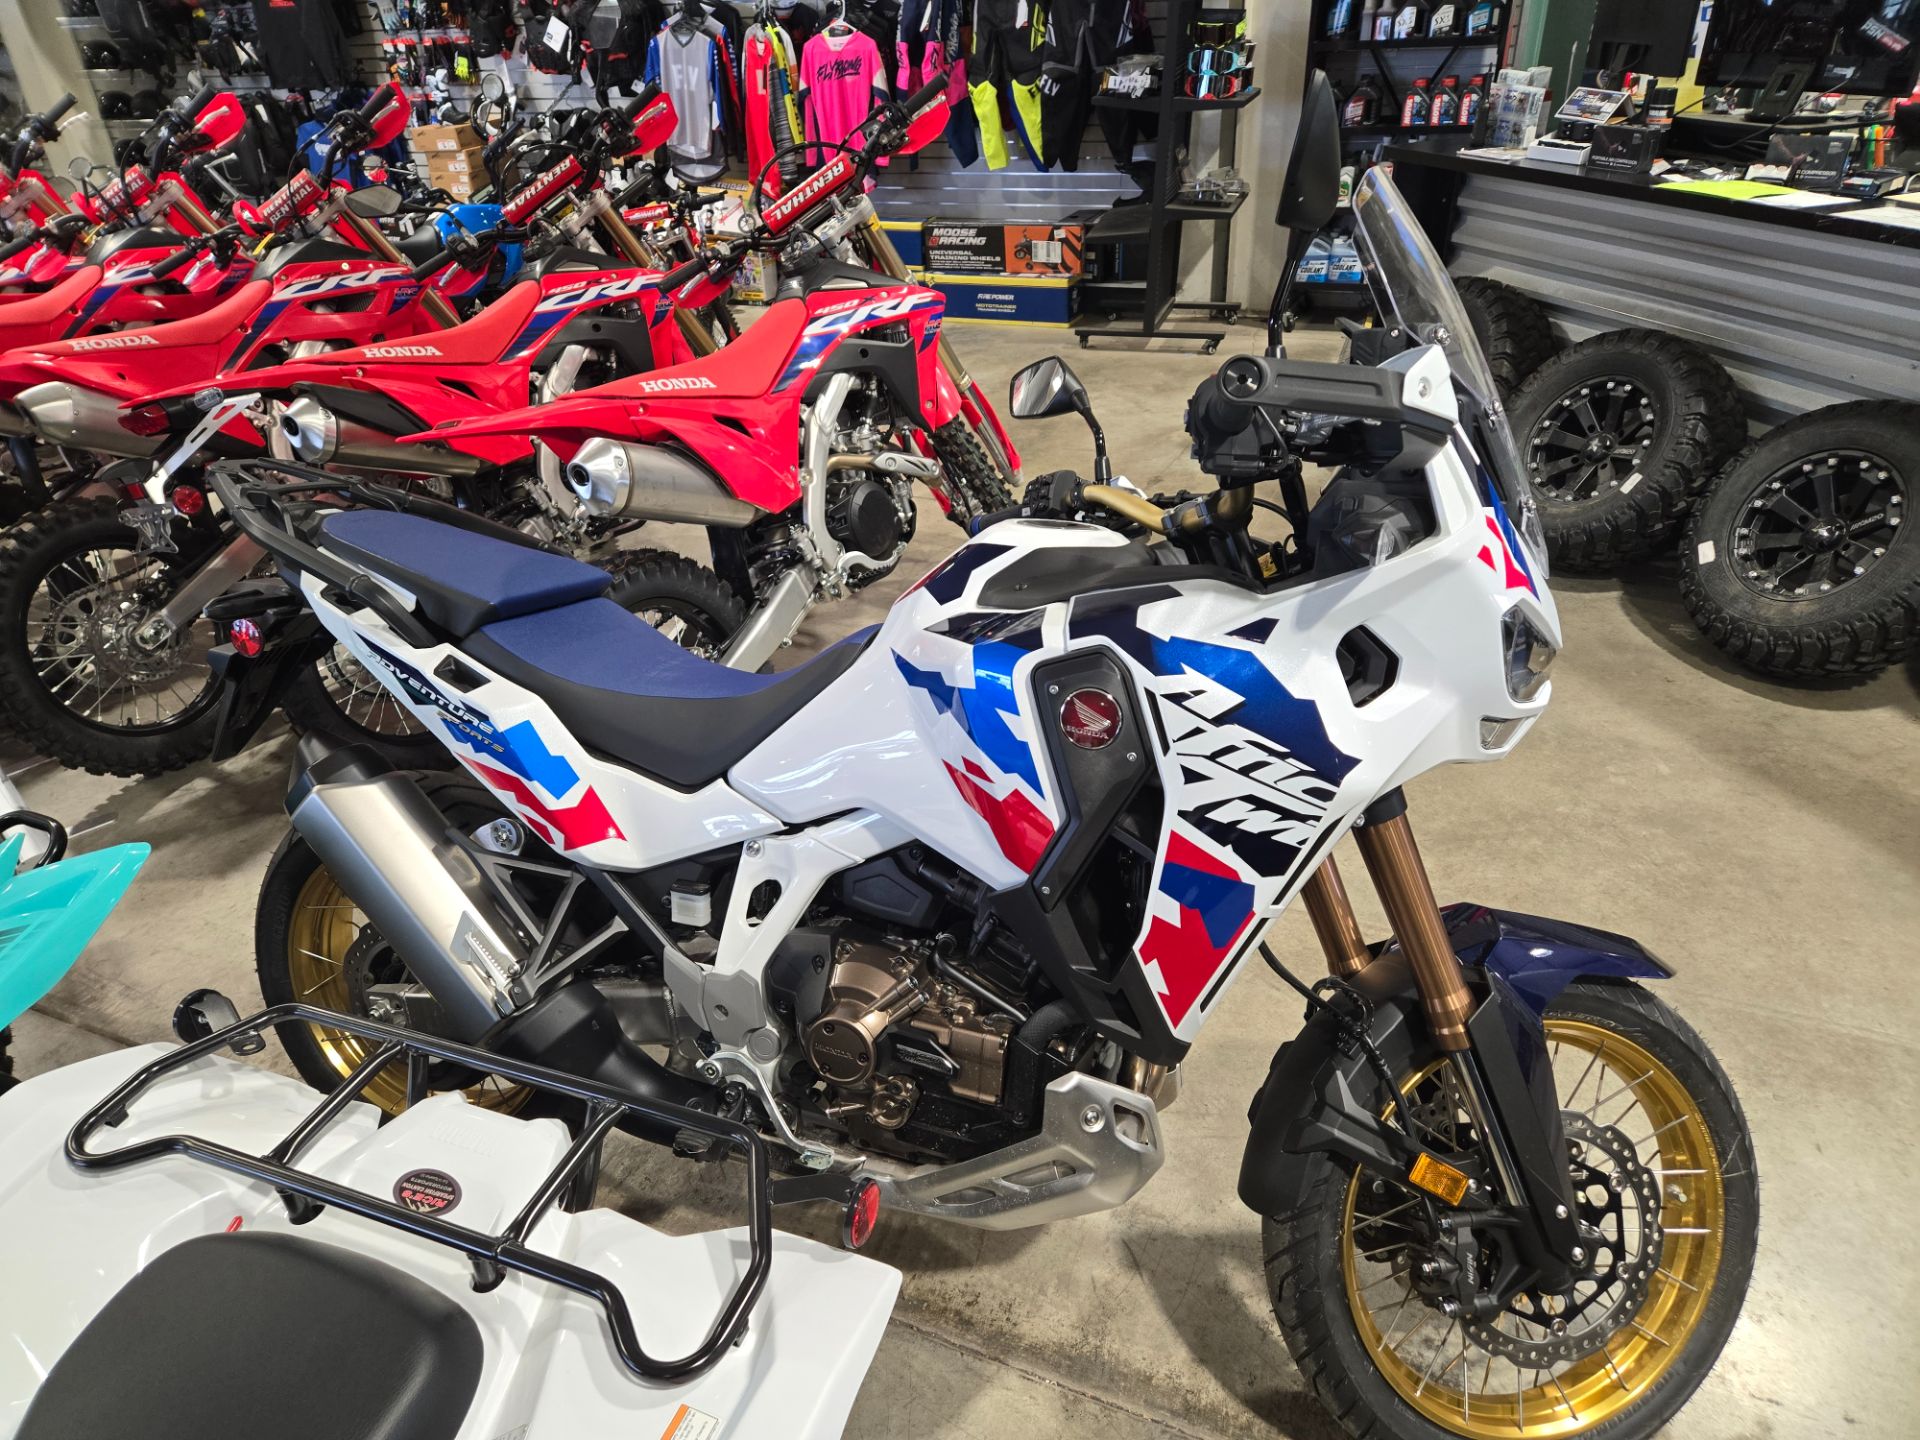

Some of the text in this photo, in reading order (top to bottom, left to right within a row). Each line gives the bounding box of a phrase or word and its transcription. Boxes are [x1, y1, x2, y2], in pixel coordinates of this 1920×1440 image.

[1039, 74, 1060, 97] FLY
[1403, 98, 1414, 124] MOTUL
[1432, 98, 1442, 124] MOTUL
[1461, 97, 1471, 123] MOTUL
[509, 157, 571, 212] RENTHAL
[771, 160, 845, 220] RENTHAL
[932, 228, 977, 237] MOOSE
[939, 237, 987, 246] RACING
[270, 266, 412, 301] CRF
[537, 273, 664, 312] CRF
[802, 290, 937, 336] CRF
[975, 302, 1017, 310] MOTOTRAINER
[67, 334, 160, 351] HONDA
[361, 345, 443, 358] HONDA
[638, 376, 717, 393] HONDA
[367, 650, 495, 735] ADVENTURE
[436, 709, 505, 753] SPORTS
[1066, 725, 1109, 740] HONDA
[410, 1177, 453, 1192] MOTORSPORTS
